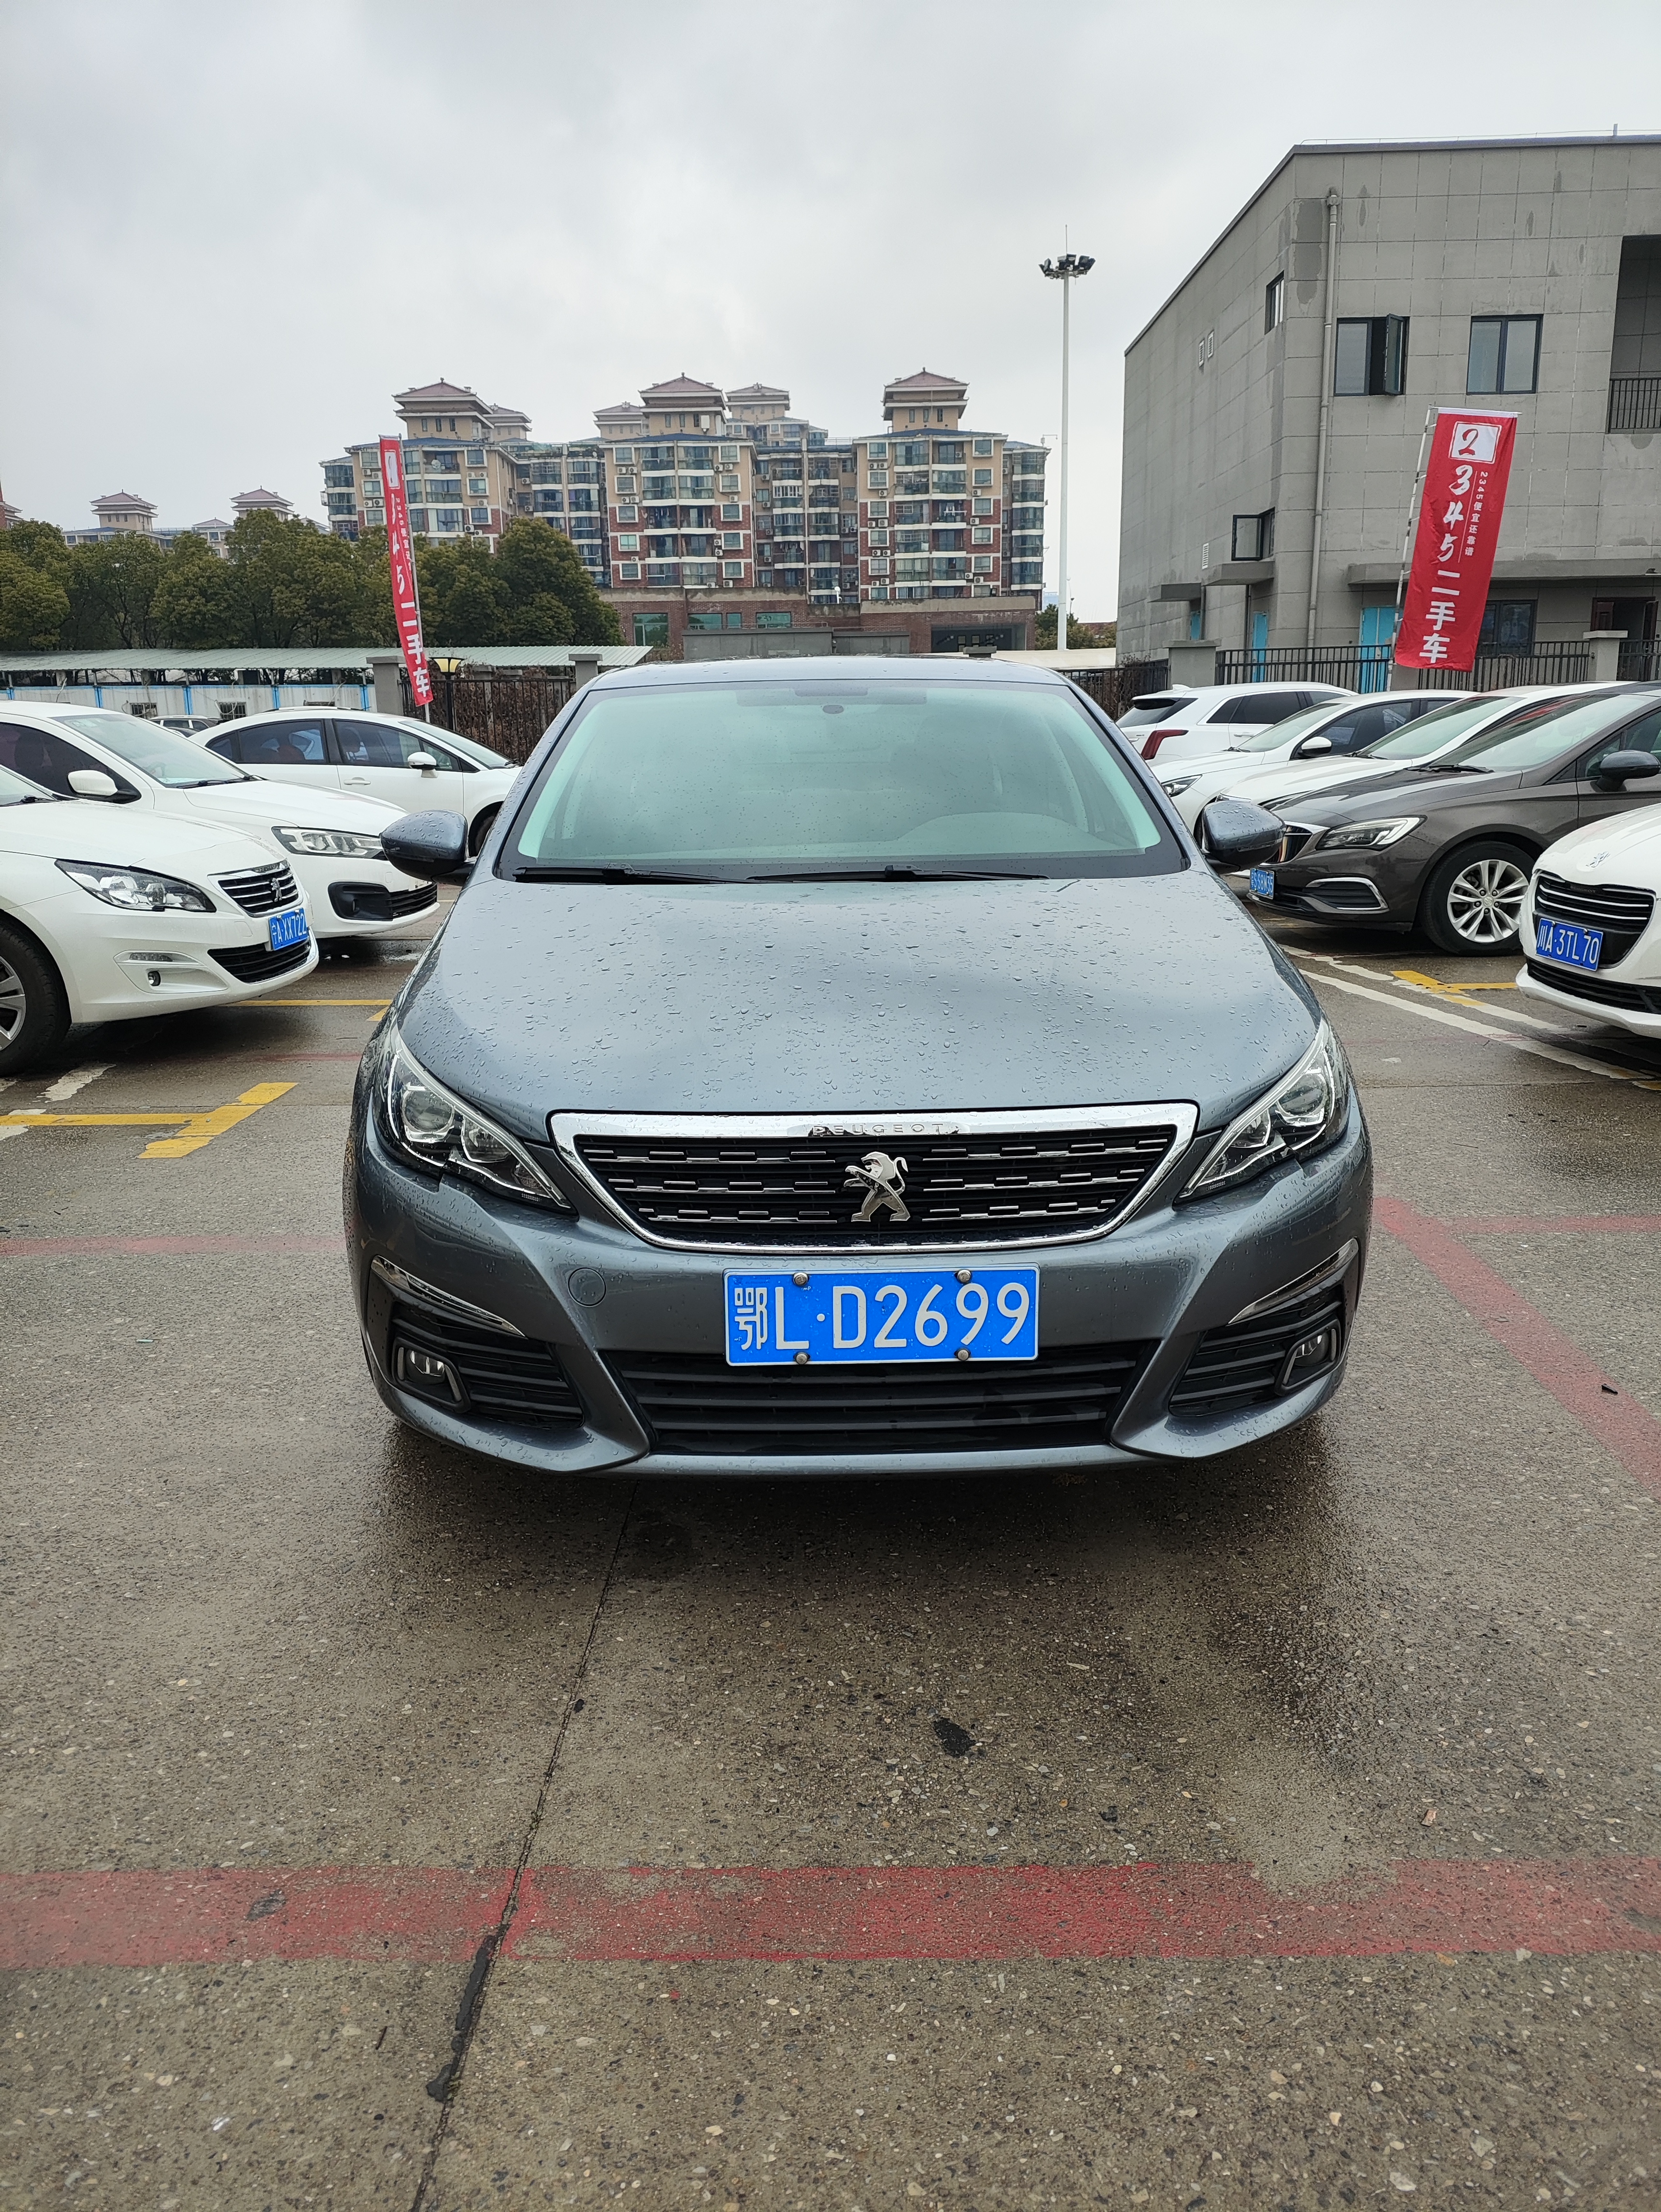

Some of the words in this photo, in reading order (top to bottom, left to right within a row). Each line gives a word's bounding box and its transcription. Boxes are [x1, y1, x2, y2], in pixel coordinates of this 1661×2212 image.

[1464, 471, 1488, 556] 2345便宜还靠谱
[813, 1123, 943, 1136] PEUGEOT
[734, 1282, 1030, 1350] 鄂L·D2699
